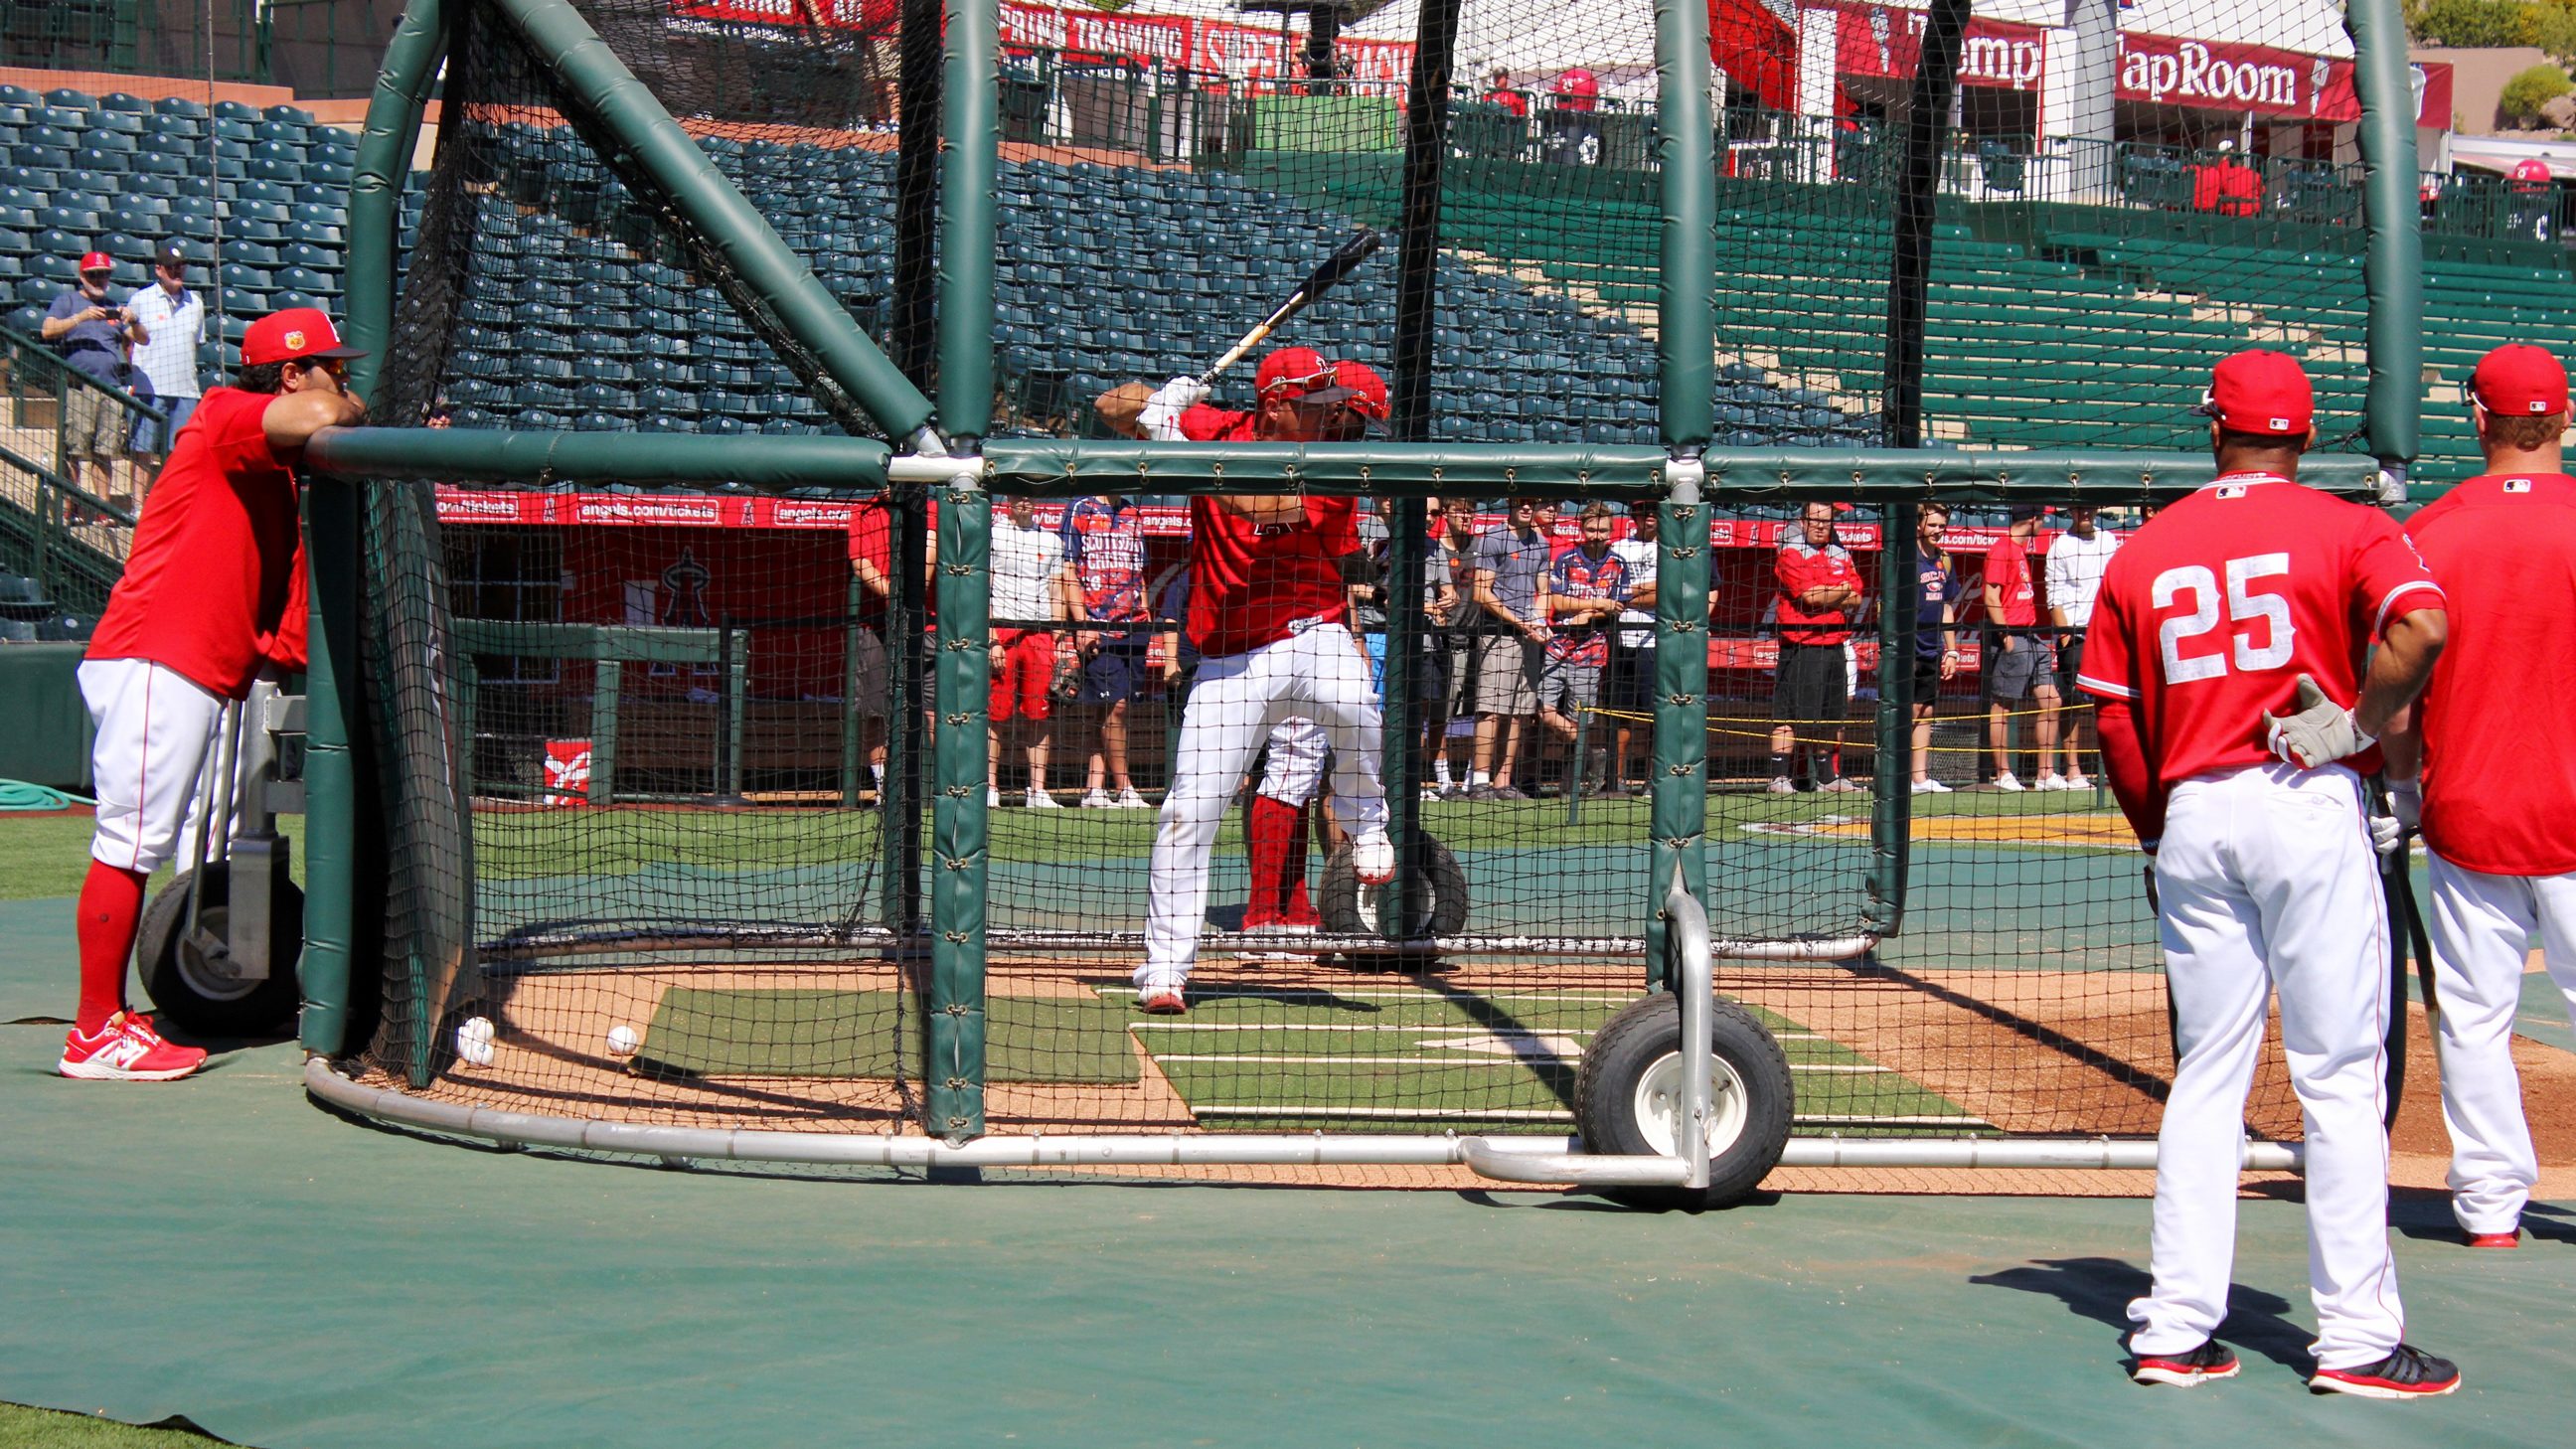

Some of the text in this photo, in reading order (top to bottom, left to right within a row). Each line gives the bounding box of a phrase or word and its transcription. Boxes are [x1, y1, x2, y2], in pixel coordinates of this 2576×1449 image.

[1073, 17, 1183, 60] TRAINING
[2116, 34, 2296, 105] apRoom
[581, 501, 716, 520] angels.com/tickets
[2151, 552, 2297, 686] 25
